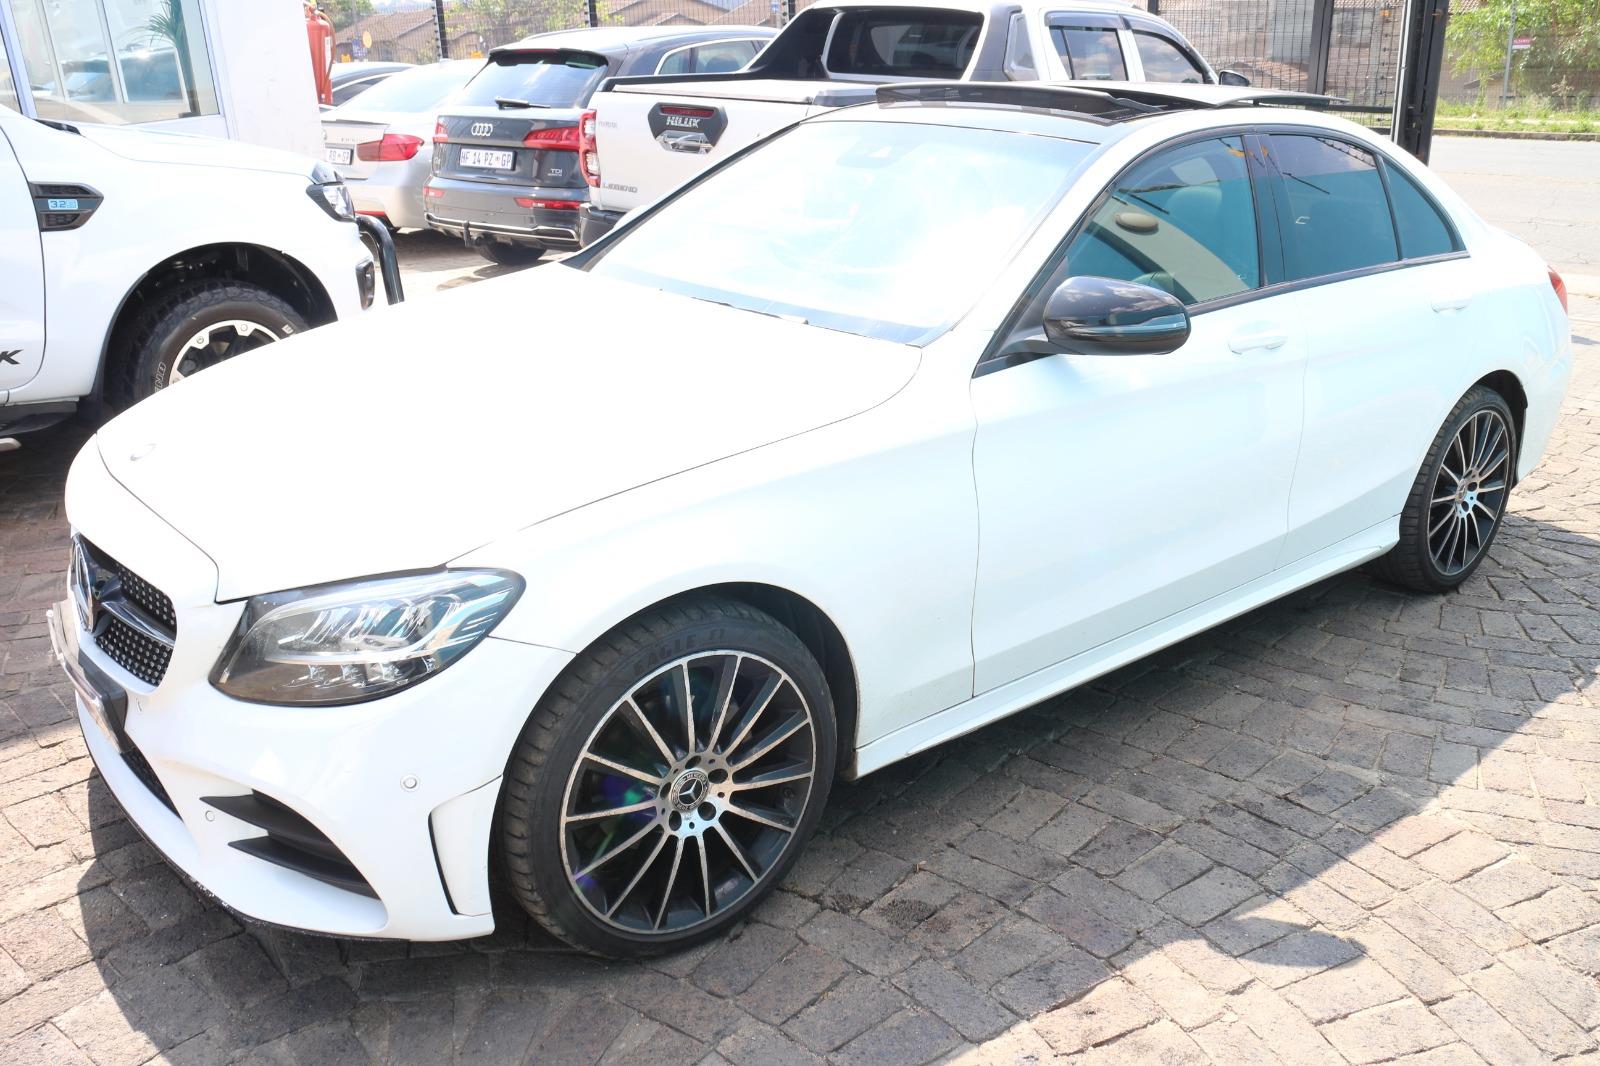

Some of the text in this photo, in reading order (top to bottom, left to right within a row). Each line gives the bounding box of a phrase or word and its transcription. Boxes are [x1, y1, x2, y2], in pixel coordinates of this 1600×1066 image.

[666, 116, 701, 130] HILUX
[501, 153, 513, 167] GP
[603, 183, 638, 195] LEGEND
